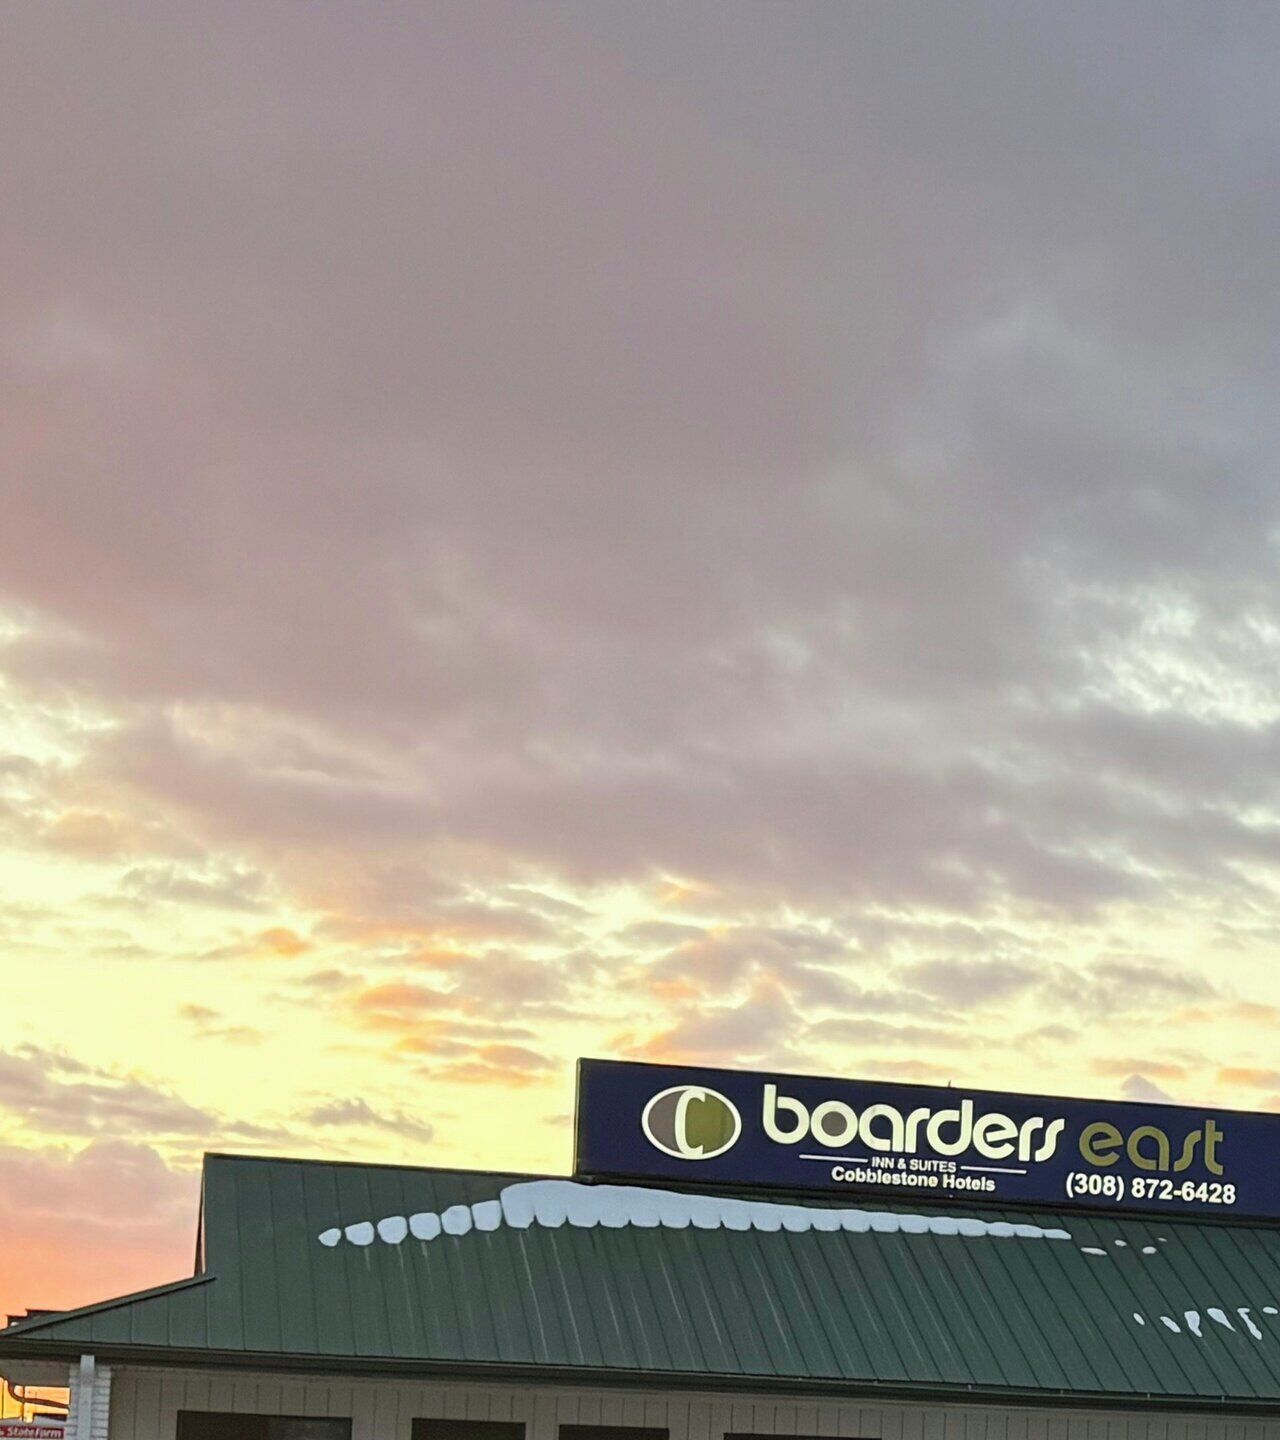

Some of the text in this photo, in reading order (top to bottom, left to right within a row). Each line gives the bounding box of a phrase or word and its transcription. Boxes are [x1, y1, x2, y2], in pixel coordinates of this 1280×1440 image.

[762, 1083, 1224, 1176] boarders east
[831, 1166, 996, 1192] Cobblestone Hotels
[871, 1156, 957, 1173] INN & SUITES
[1065, 1171, 1237, 1205] (308) 872-6428
